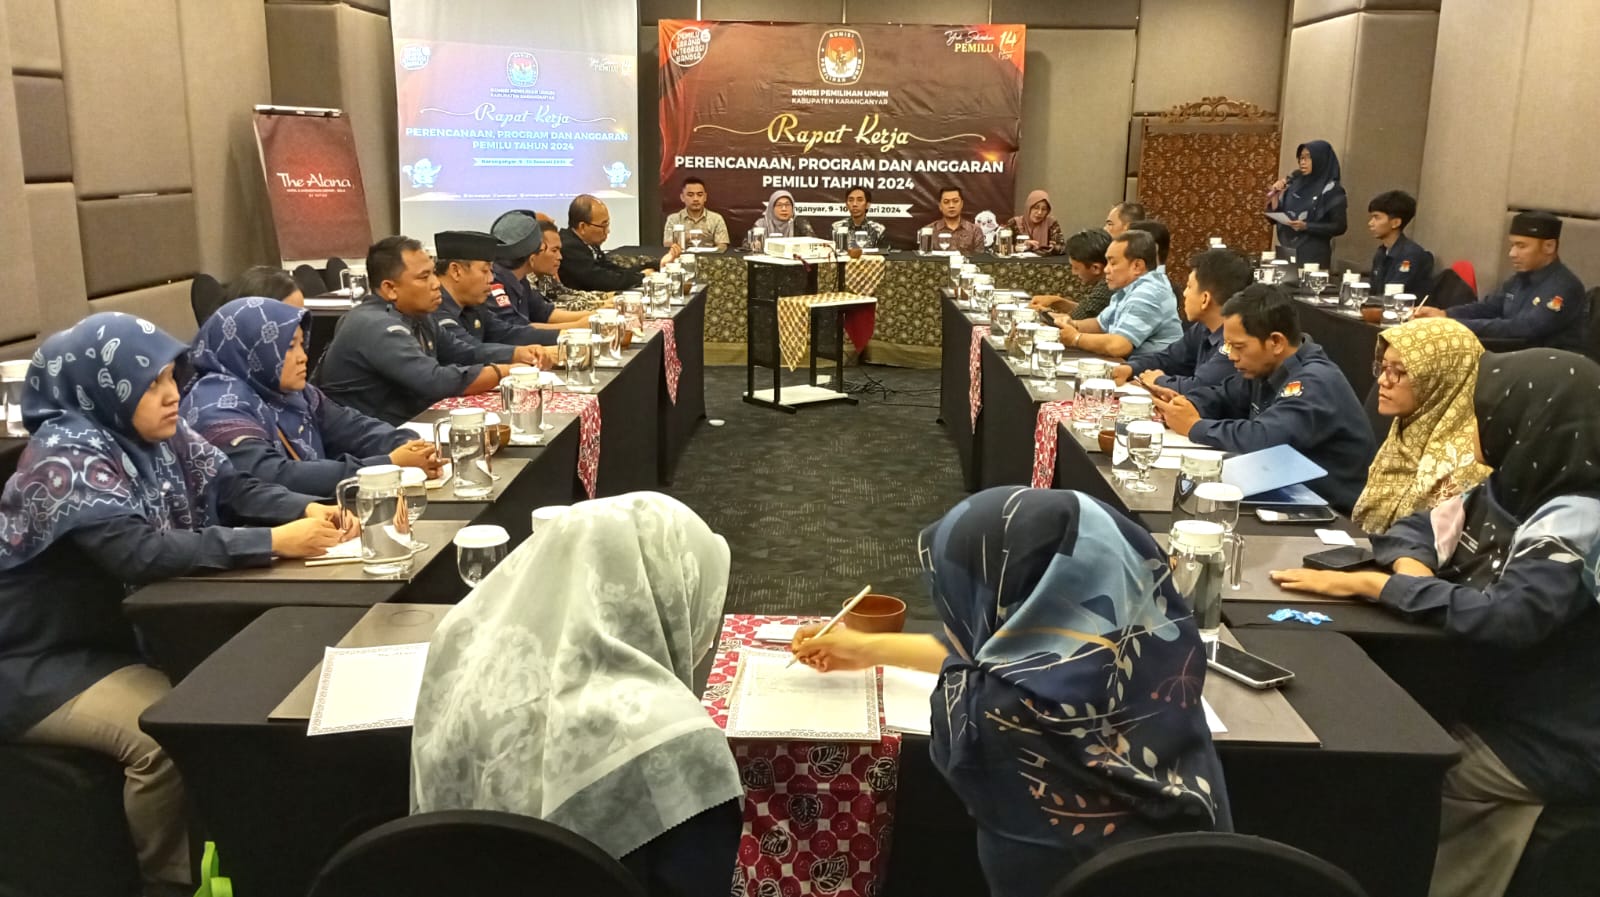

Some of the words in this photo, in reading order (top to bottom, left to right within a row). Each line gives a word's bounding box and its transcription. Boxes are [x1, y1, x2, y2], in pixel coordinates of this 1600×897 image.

[954, 43, 994, 53] PEMILU
[792, 89, 819, 97] KOMISI
[820, 89, 863, 97] PEMILIHAN
[474, 102, 533, 129] Rapat
[535, 104, 569, 129] Kerja
[405, 127, 496, 140] PERENCANAAN,
[497, 130, 549, 140] PROGRAM
[551, 131, 572, 140] DAN
[573, 132, 628, 141] ANGGARAN
[767, 113, 853, 154] Rapat
[854, 113, 910, 153] Kerja
[472, 140, 512, 150] PEMILU
[513, 141, 549, 151] TAHUN
[550, 141, 574, 151] 2024
[674, 156, 795, 171] PERENCANAAN,
[798, 158, 875, 171] PROGRAM
[878, 159, 912, 172] DAN
[914, 160, 1004, 173] ANGGARAN
[276, 172, 305, 188] The
[306, 172, 352, 188] Alana
[762, 175, 819, 188] PEMILU
[821, 176, 874, 189] TAHUN
[877, 177, 915, 190] 2024
